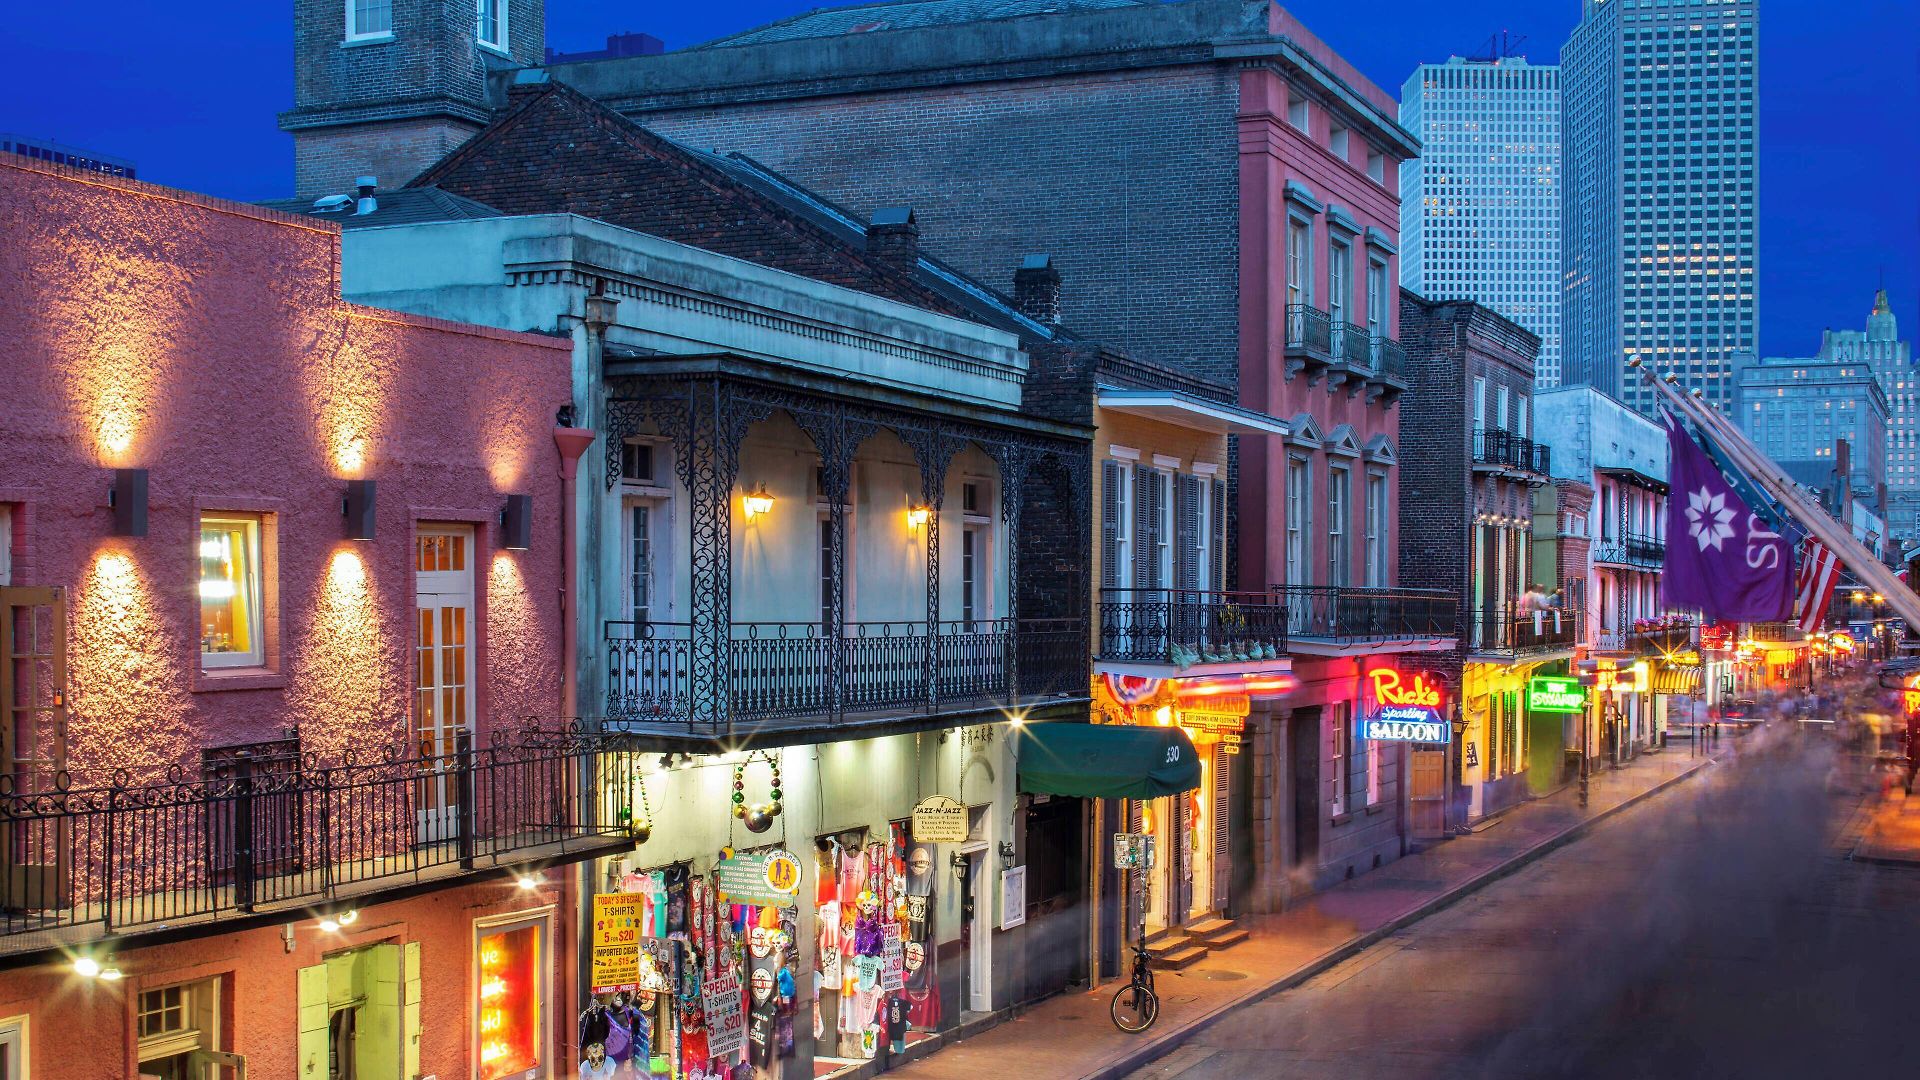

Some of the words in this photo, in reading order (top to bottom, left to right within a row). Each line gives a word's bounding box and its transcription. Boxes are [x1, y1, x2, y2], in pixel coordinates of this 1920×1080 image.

[1369, 668, 1440, 706] Rick's
[1546, 683, 1568, 693] THE
[1533, 693, 1584, 708] SWAMP
[1382, 706, 1428, 721] Sporting
[1370, 722, 1440, 741] SALOON
[597, 896, 619, 905] TODAY'S
[620, 895, 640, 904] SPECIAL
[603, 906, 635, 917] T-SHIRTS
[604, 932, 610, 942] 5
[618, 930, 634, 942] $20
[596, 947, 622, 957] IMPORTED
[619, 957, 629, 966] $15
[703, 976, 739, 998] SPECIAL
[708, 991, 738, 1008] T-SHIRTS
[708, 1023, 715, 1037] 5
[716, 1026, 725, 1034] FOR
[724, 1013, 741, 1033] $20
[709, 1035, 727, 1047] LOWEST
[727, 1031, 743, 1041] PRICES
